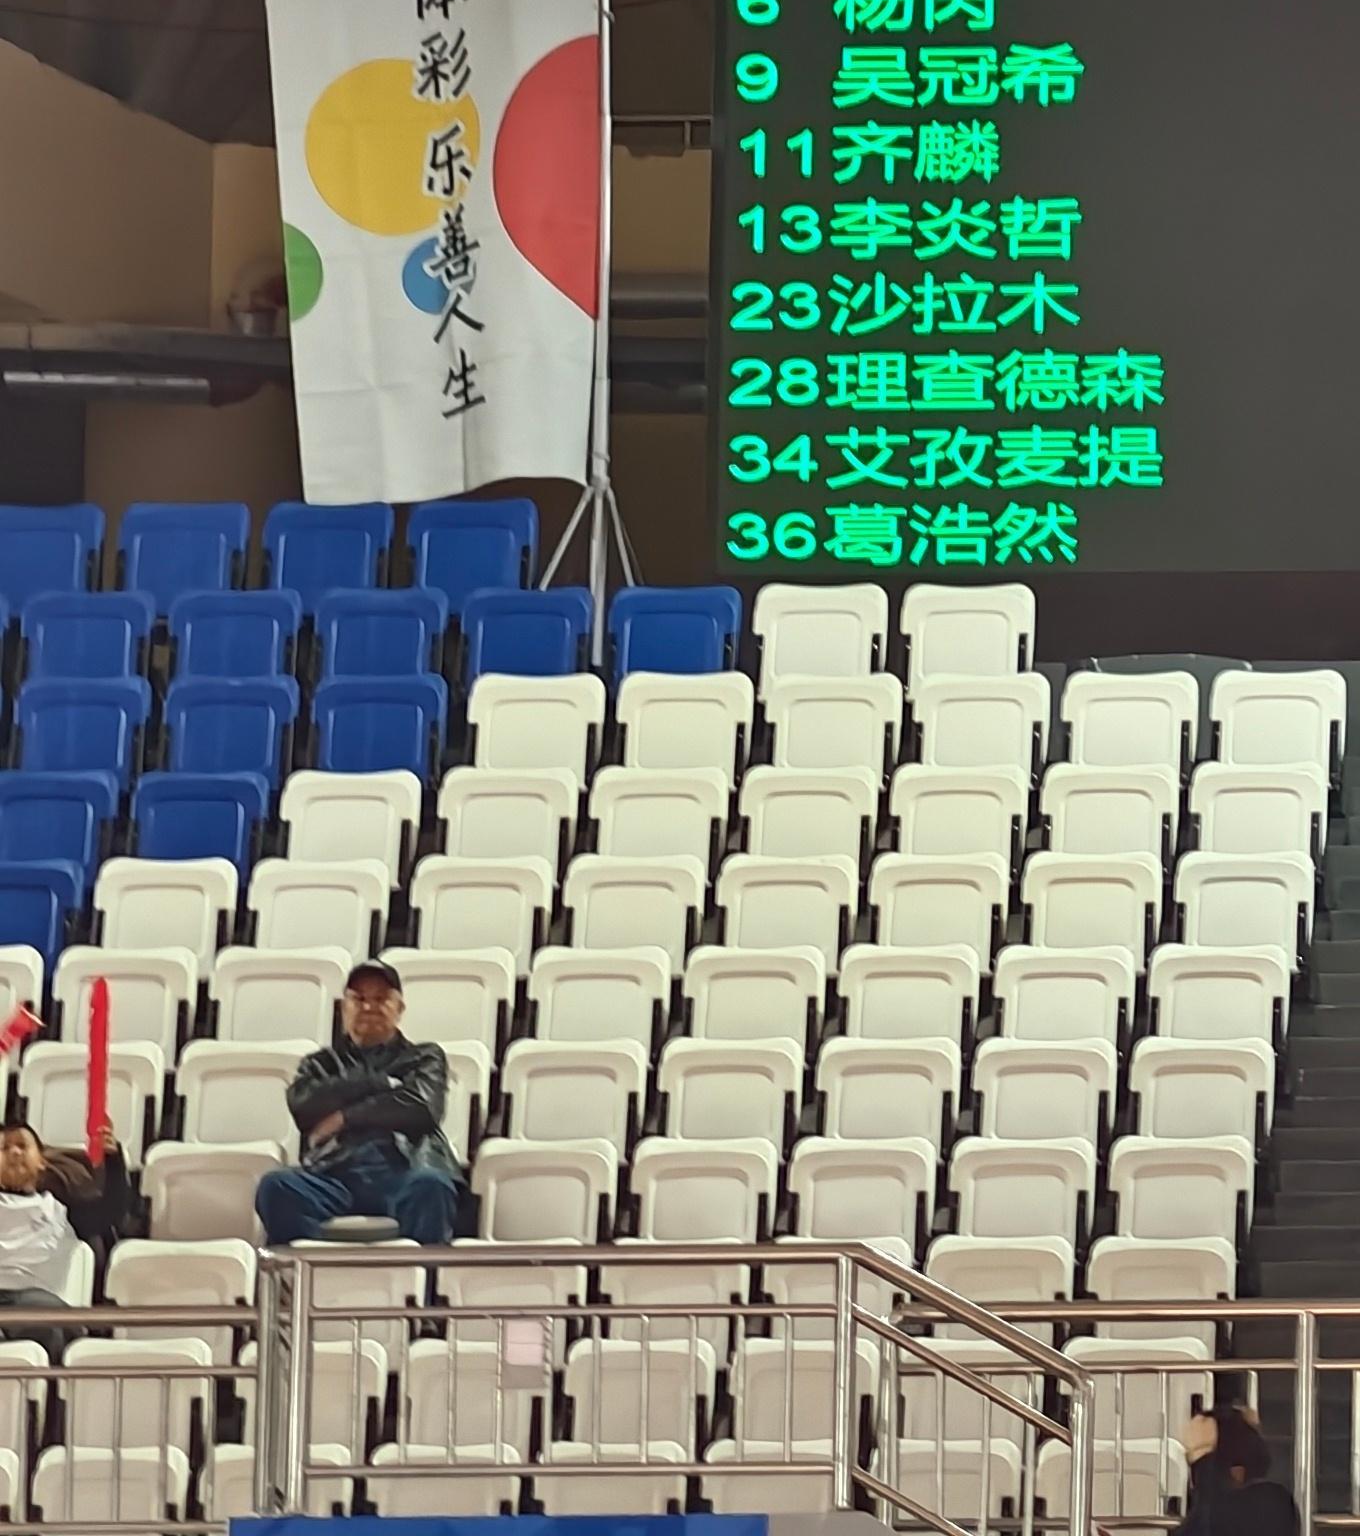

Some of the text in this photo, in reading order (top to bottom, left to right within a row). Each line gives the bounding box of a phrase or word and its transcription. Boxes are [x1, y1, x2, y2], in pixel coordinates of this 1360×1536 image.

[733, 52, 780, 104] 9
[831, 42, 1085, 110] 吴冠希
